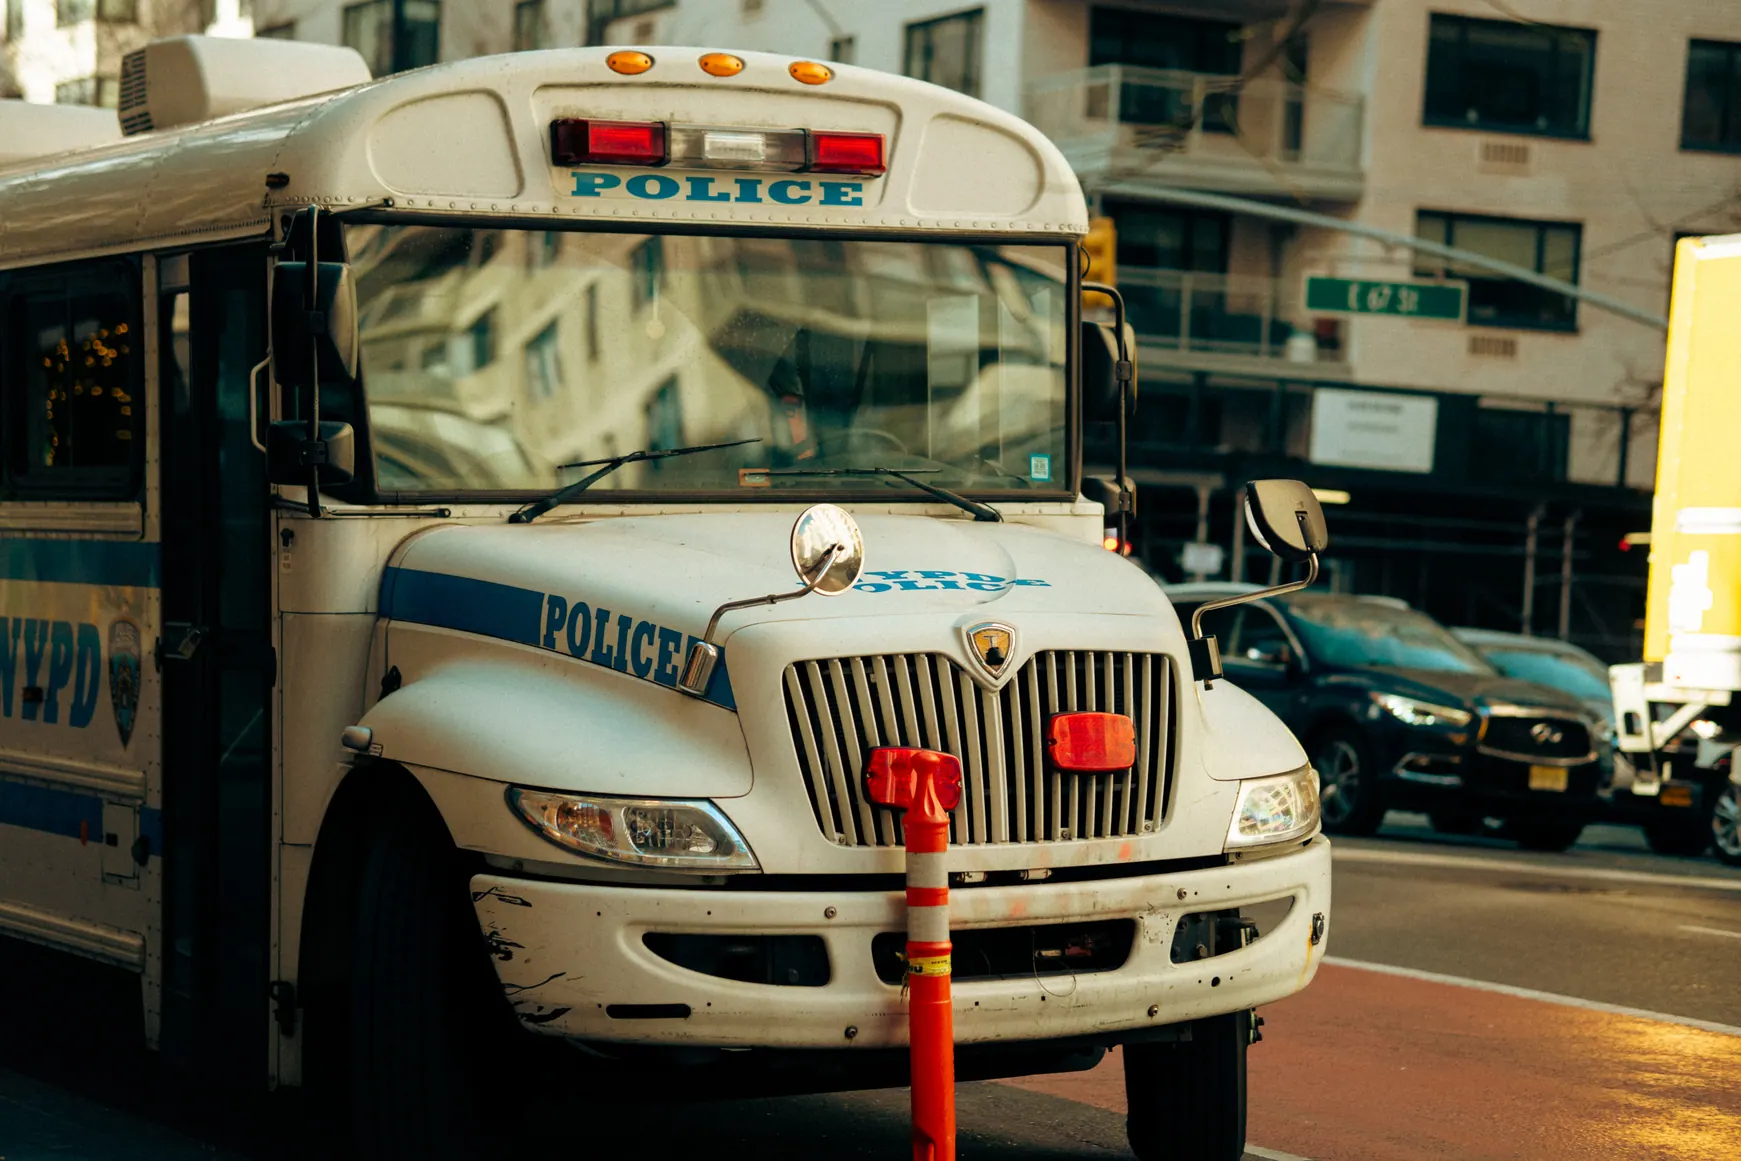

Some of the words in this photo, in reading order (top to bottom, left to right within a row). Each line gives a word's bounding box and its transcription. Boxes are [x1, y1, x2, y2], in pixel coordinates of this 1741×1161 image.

[571, 171, 863, 206] POLICE
[796, 578, 1052, 592] OLICE
[857, 570, 1006, 583] YPD
[543, 594, 683, 689] POLICE
